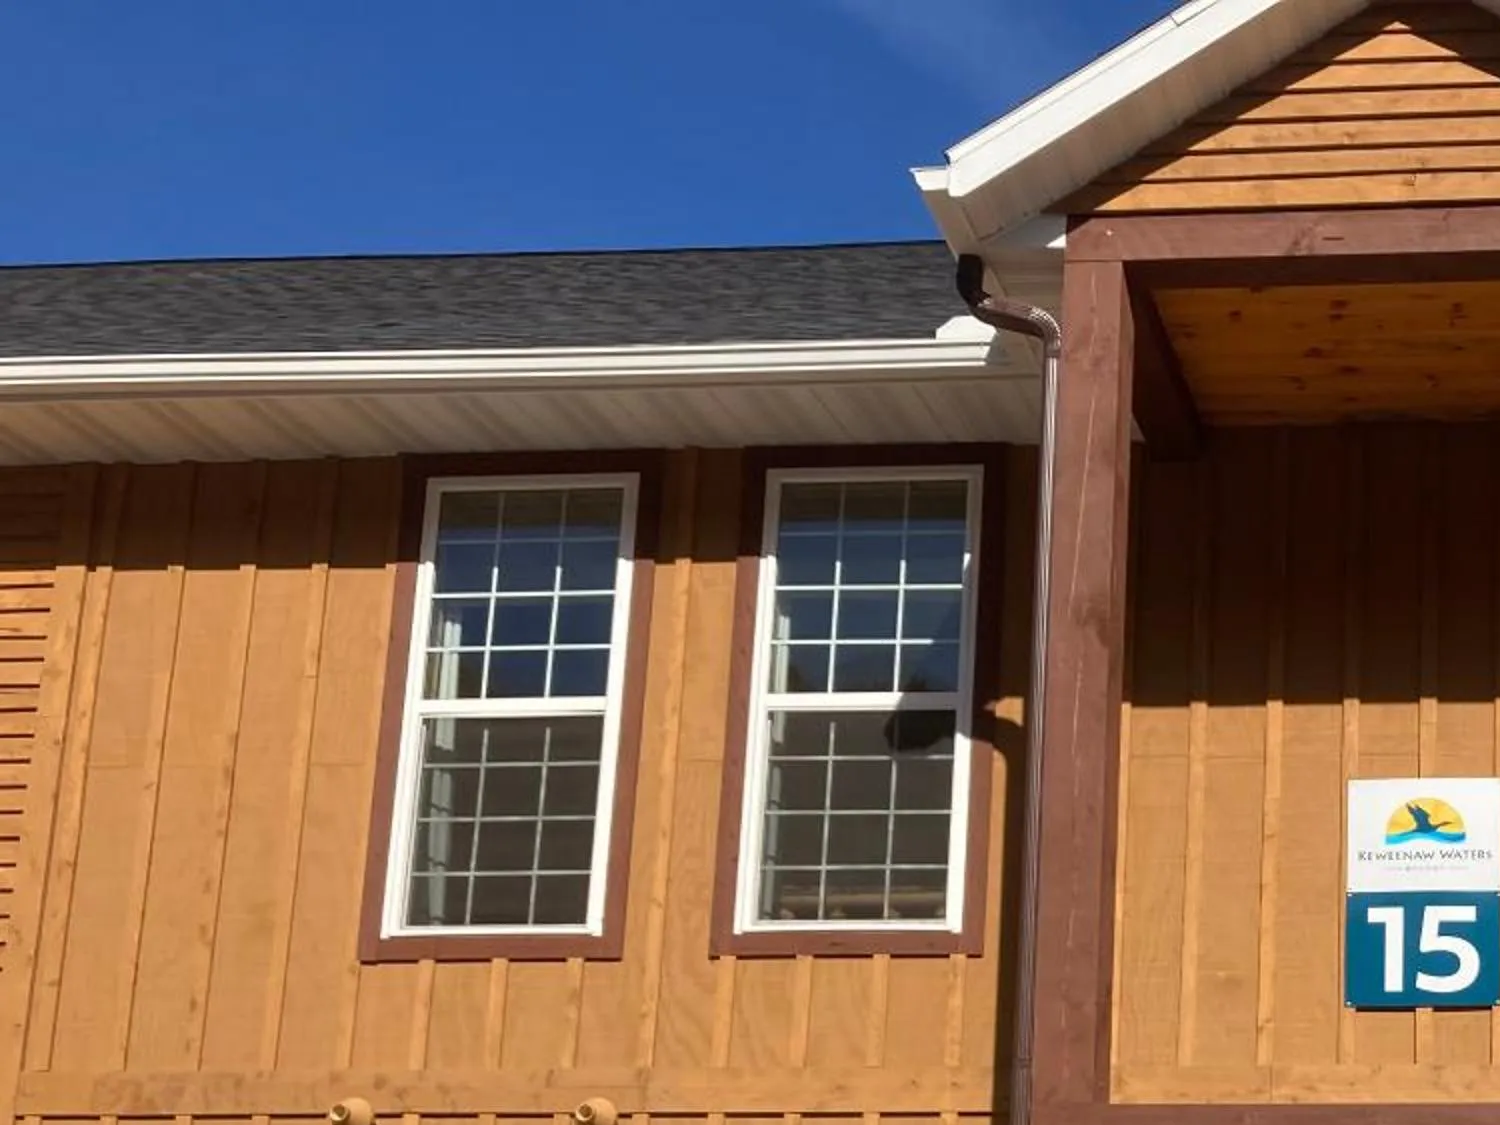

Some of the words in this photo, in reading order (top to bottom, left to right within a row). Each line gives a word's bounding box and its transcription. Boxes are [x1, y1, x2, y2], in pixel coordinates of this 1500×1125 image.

[1358, 850, 1435, 861] KEWEENAW
[1439, 849, 1493, 860] WATERS
[1367, 905, 1480, 993] 15
